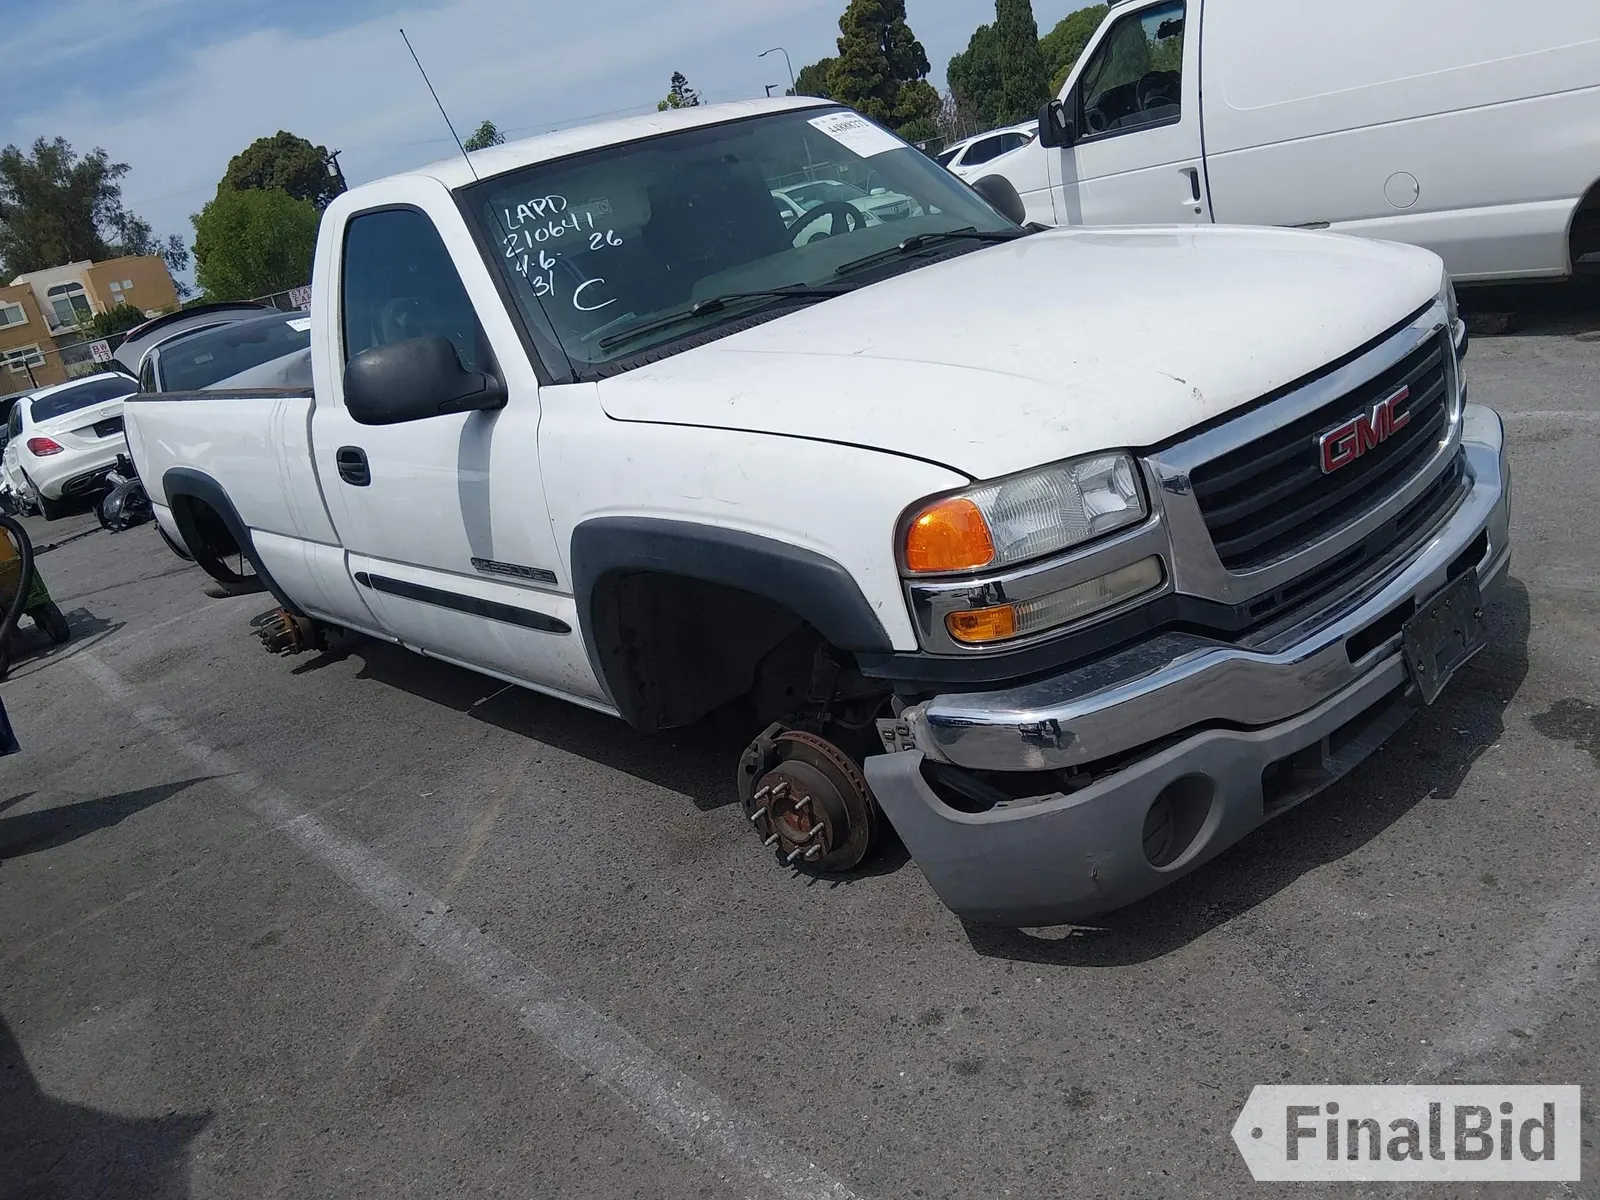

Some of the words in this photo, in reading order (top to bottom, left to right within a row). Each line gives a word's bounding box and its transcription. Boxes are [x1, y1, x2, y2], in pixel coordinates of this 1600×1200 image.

[505, 195, 567, 230] LAPD
[503, 212, 594, 258] 210641
[589, 229, 623, 250] 26
[292, 287, 312, 297] STAT
[532, 269, 555, 297] 31
[573, 278, 618, 311] C
[92, 343, 107, 353] BW
[97, 352, 111, 362] 13
[1320, 384, 1410, 475] GMC
